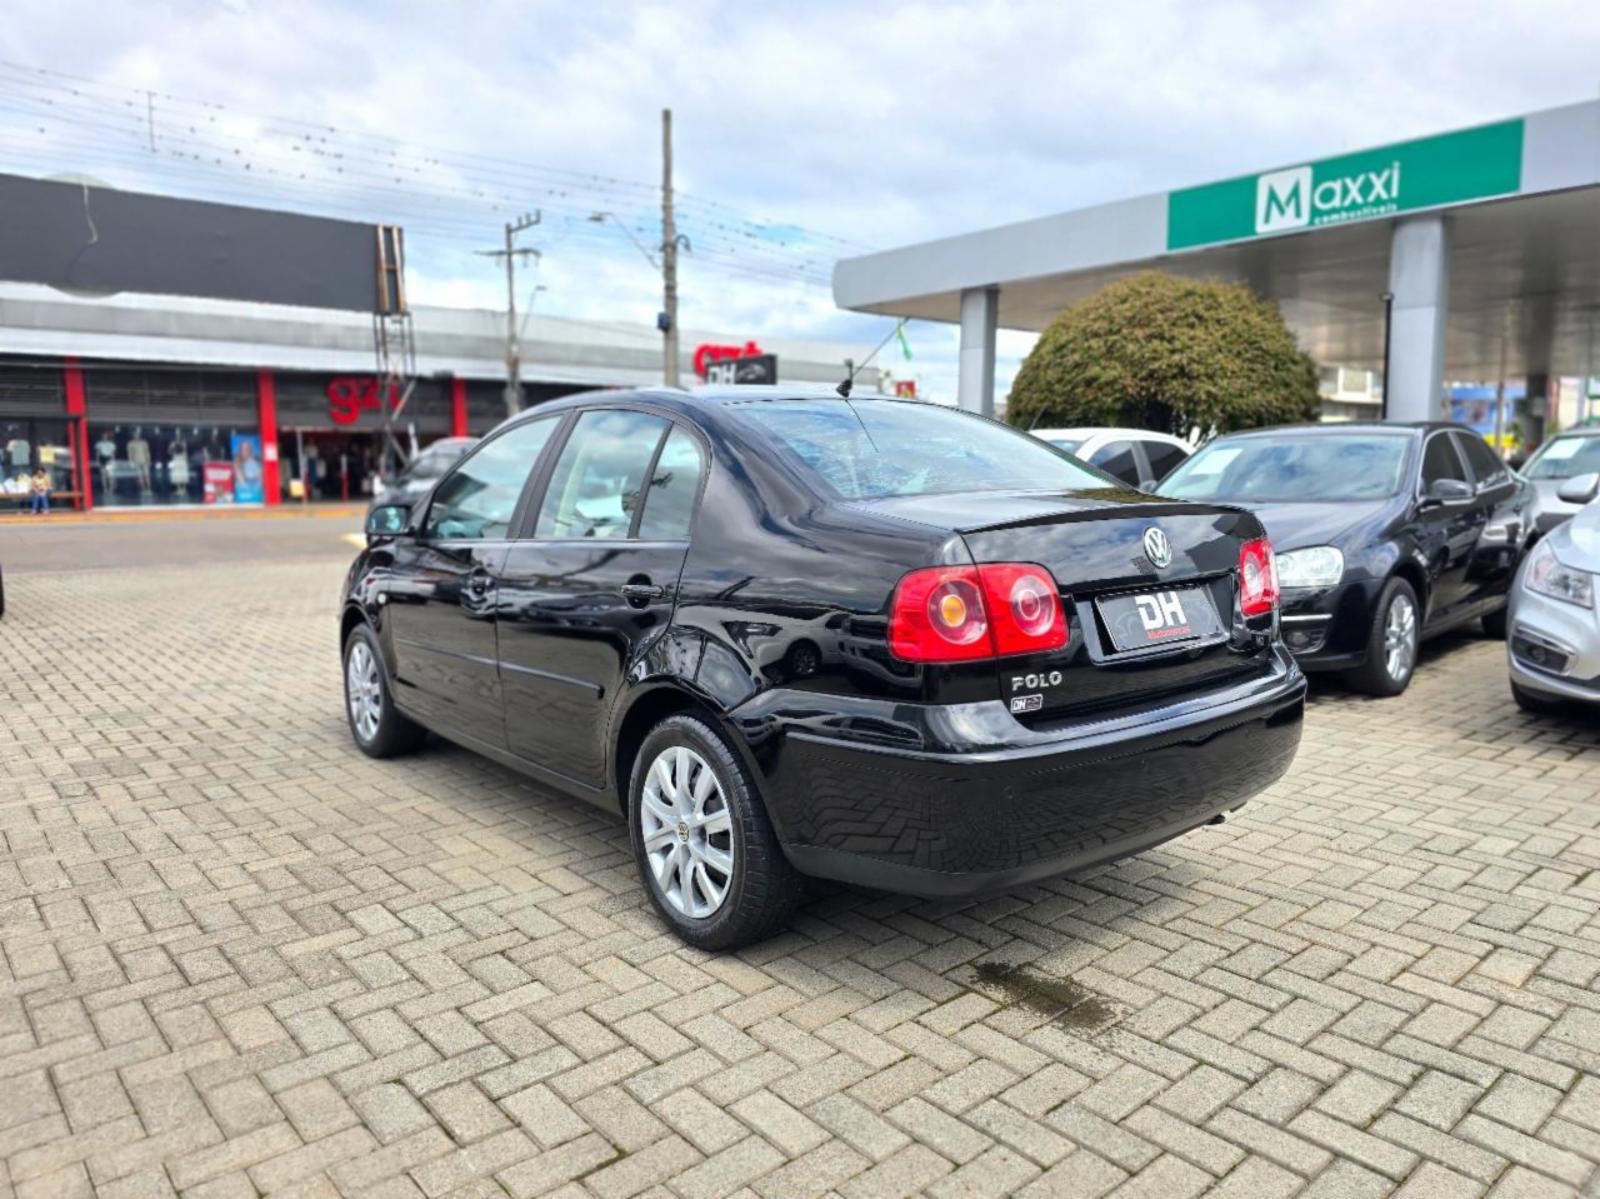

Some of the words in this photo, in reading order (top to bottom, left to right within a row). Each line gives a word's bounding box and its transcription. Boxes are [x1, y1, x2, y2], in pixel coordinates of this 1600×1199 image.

[1263, 161, 1400, 225] Maxxi
[1135, 590, 1187, 630] DH
[1011, 671, 1062, 691] POLO
